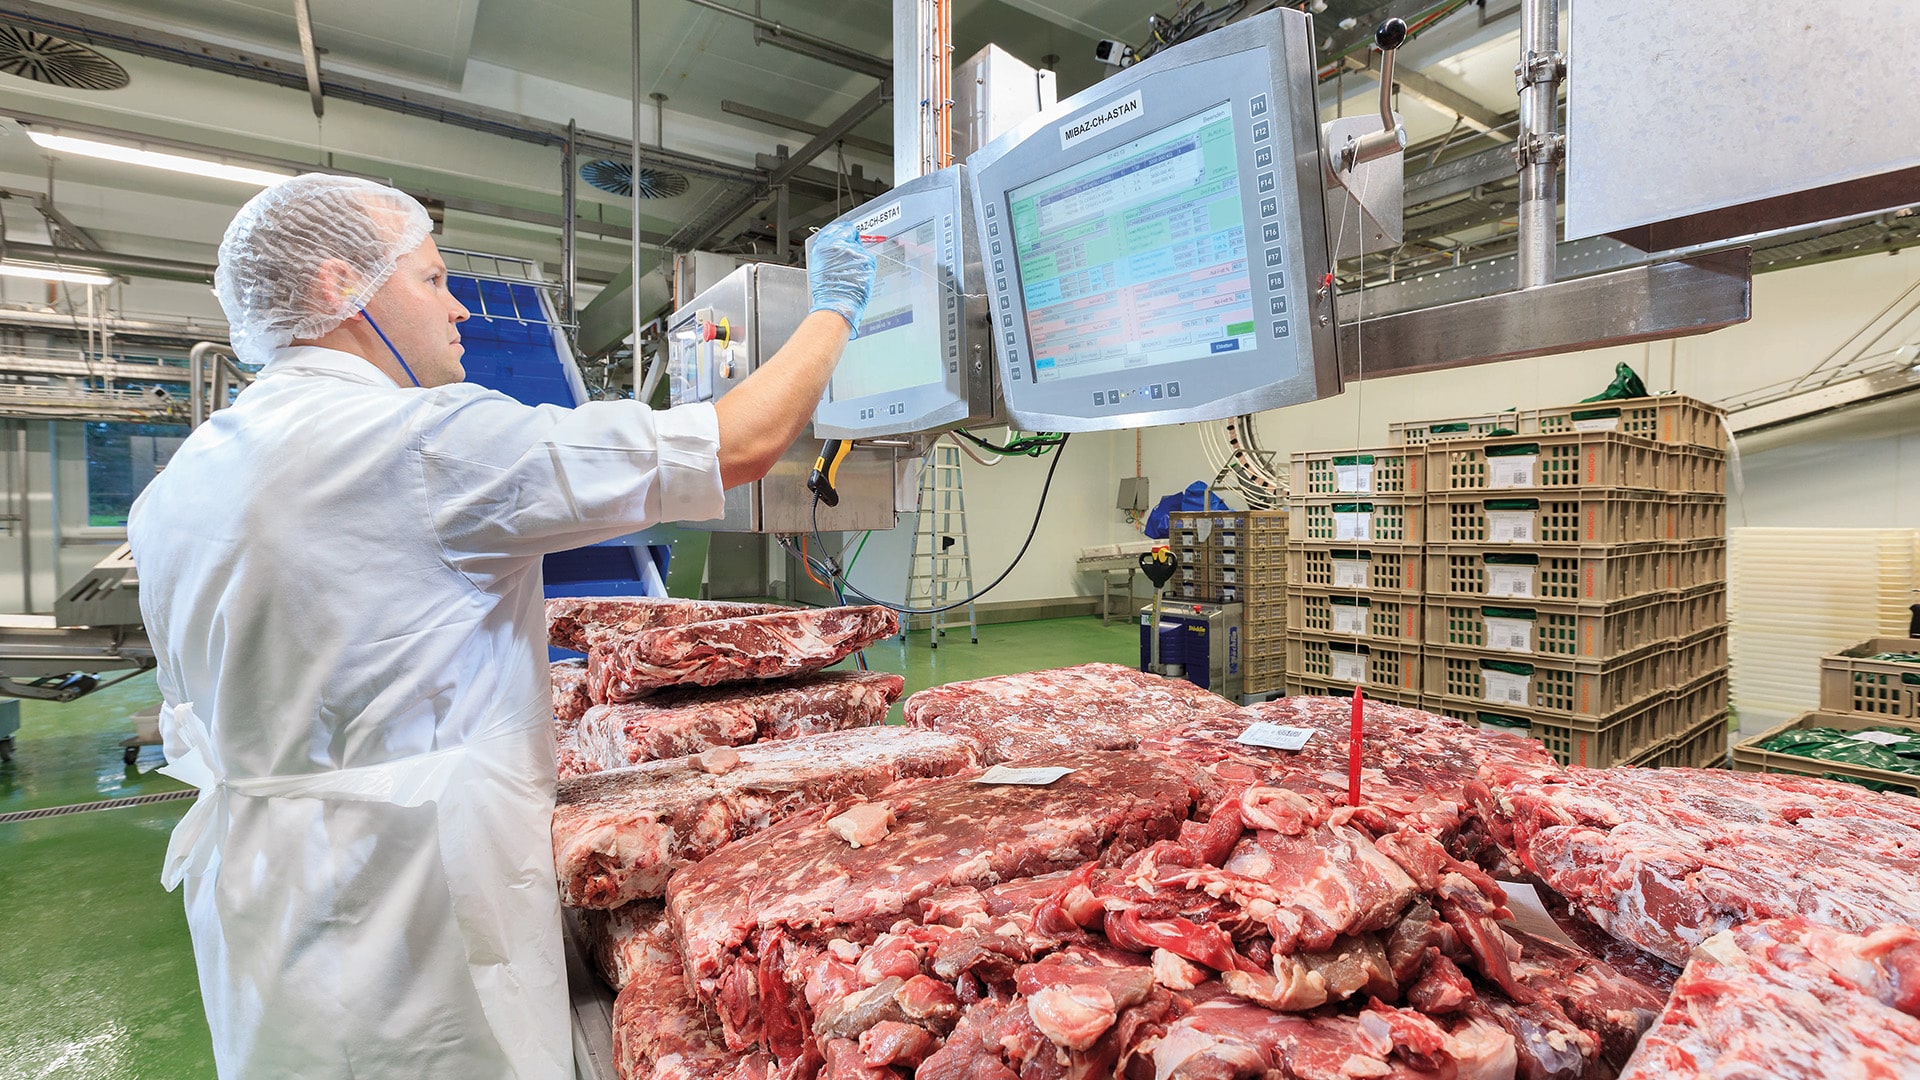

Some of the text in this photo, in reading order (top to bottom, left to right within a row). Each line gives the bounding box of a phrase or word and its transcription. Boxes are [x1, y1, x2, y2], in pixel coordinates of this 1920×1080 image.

[1252, 101, 1264, 111] F11
[1065, 100, 1137, 141] MIBAZ-CH-ASTAN
[1255, 127, 1267, 136] F12
[1258, 153, 1270, 162] F13
[1260, 178, 1272, 187] F14
[1262, 204, 1275, 213] F15
[1265, 229, 1277, 238] F16
[1268, 252, 1279, 261] F17
[1270, 277, 1282, 286] F18
[1272, 301, 1283, 310] F19
[1275, 326, 1286, 334] F20
[1154, 388, 1158, 396] F
[1409, 463, 1417, 490] MIGROS
[1586, 568, 1594, 597] MIGROS
[1582, 684, 1590, 714] MIGROS
